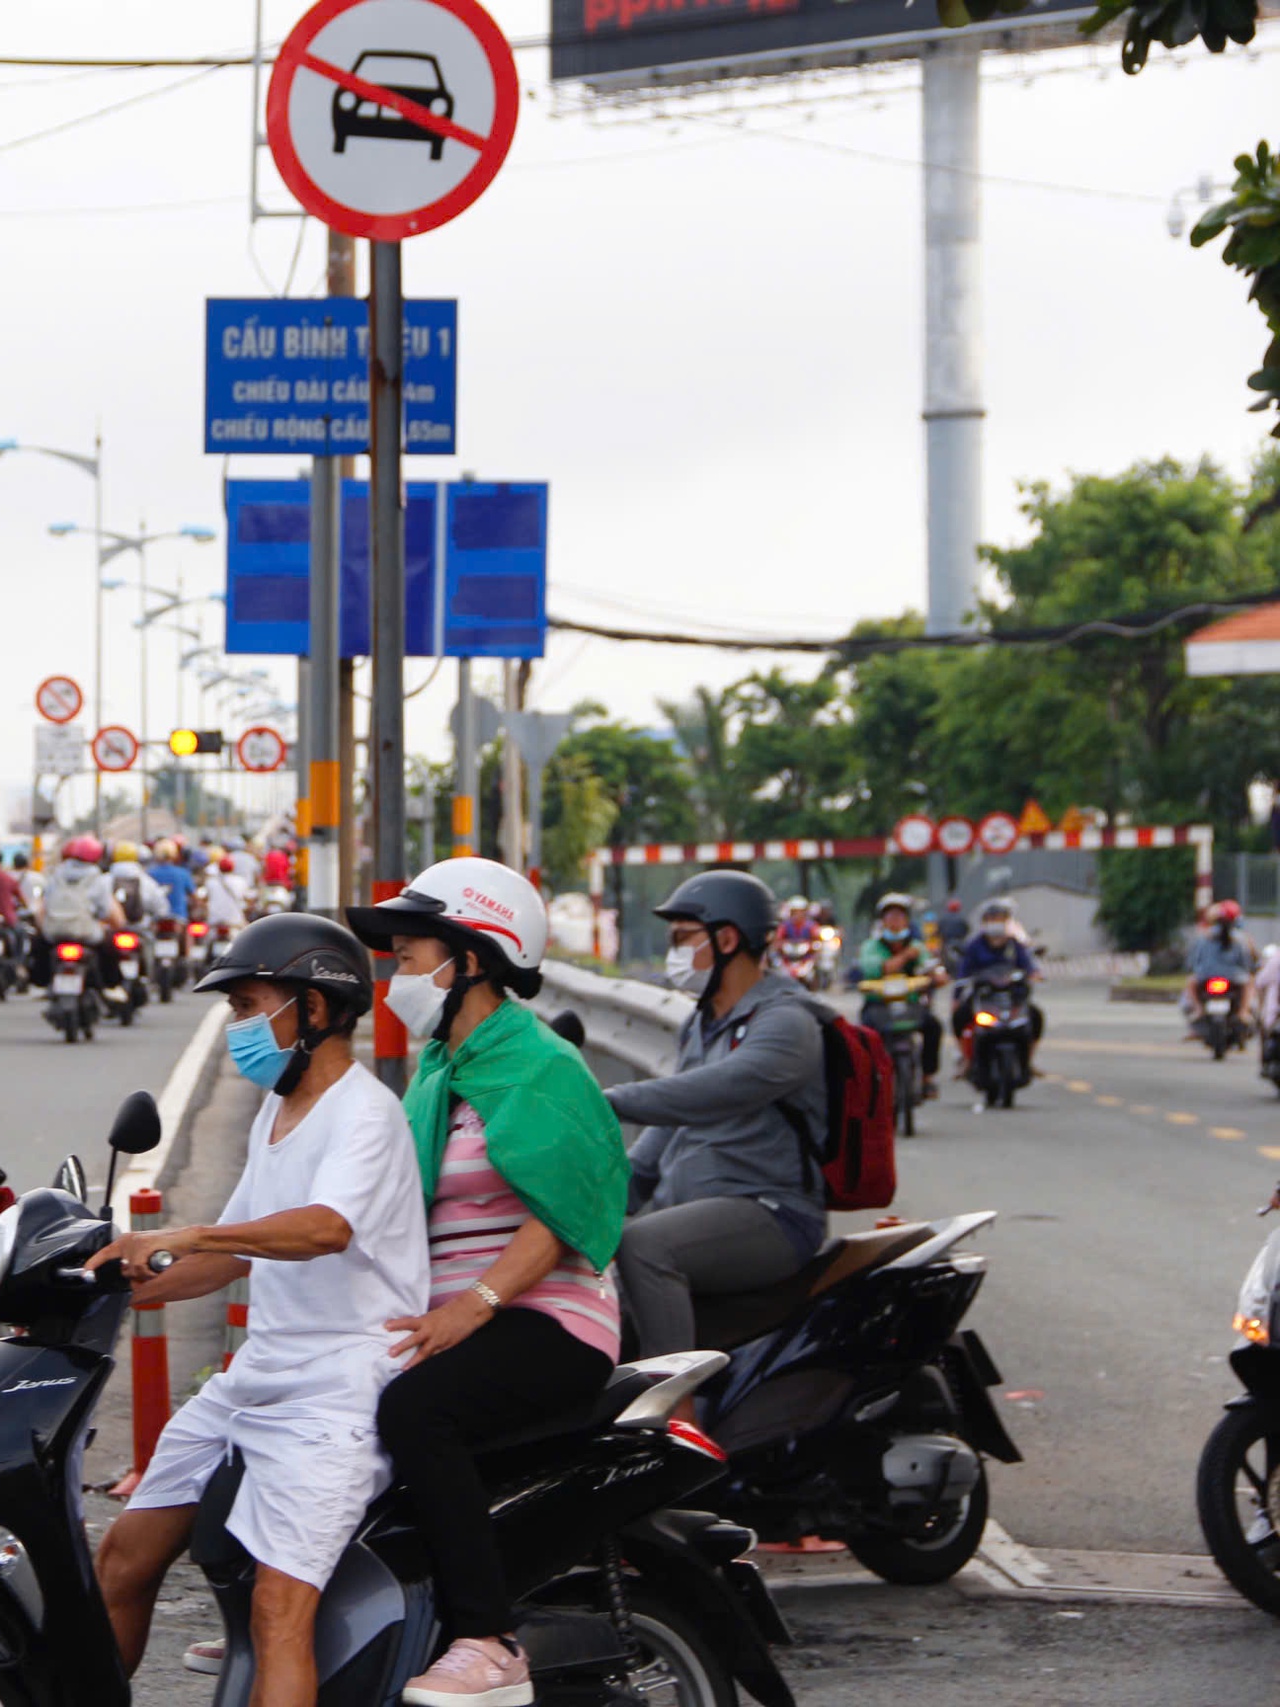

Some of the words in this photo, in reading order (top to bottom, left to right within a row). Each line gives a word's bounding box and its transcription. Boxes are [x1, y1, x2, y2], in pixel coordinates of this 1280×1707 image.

[283, 317, 348, 358] BÌNH
[355, 317, 430, 362] TỆU
[437, 327, 451, 358] 1
[474, 891, 515, 921] YAMAHA
